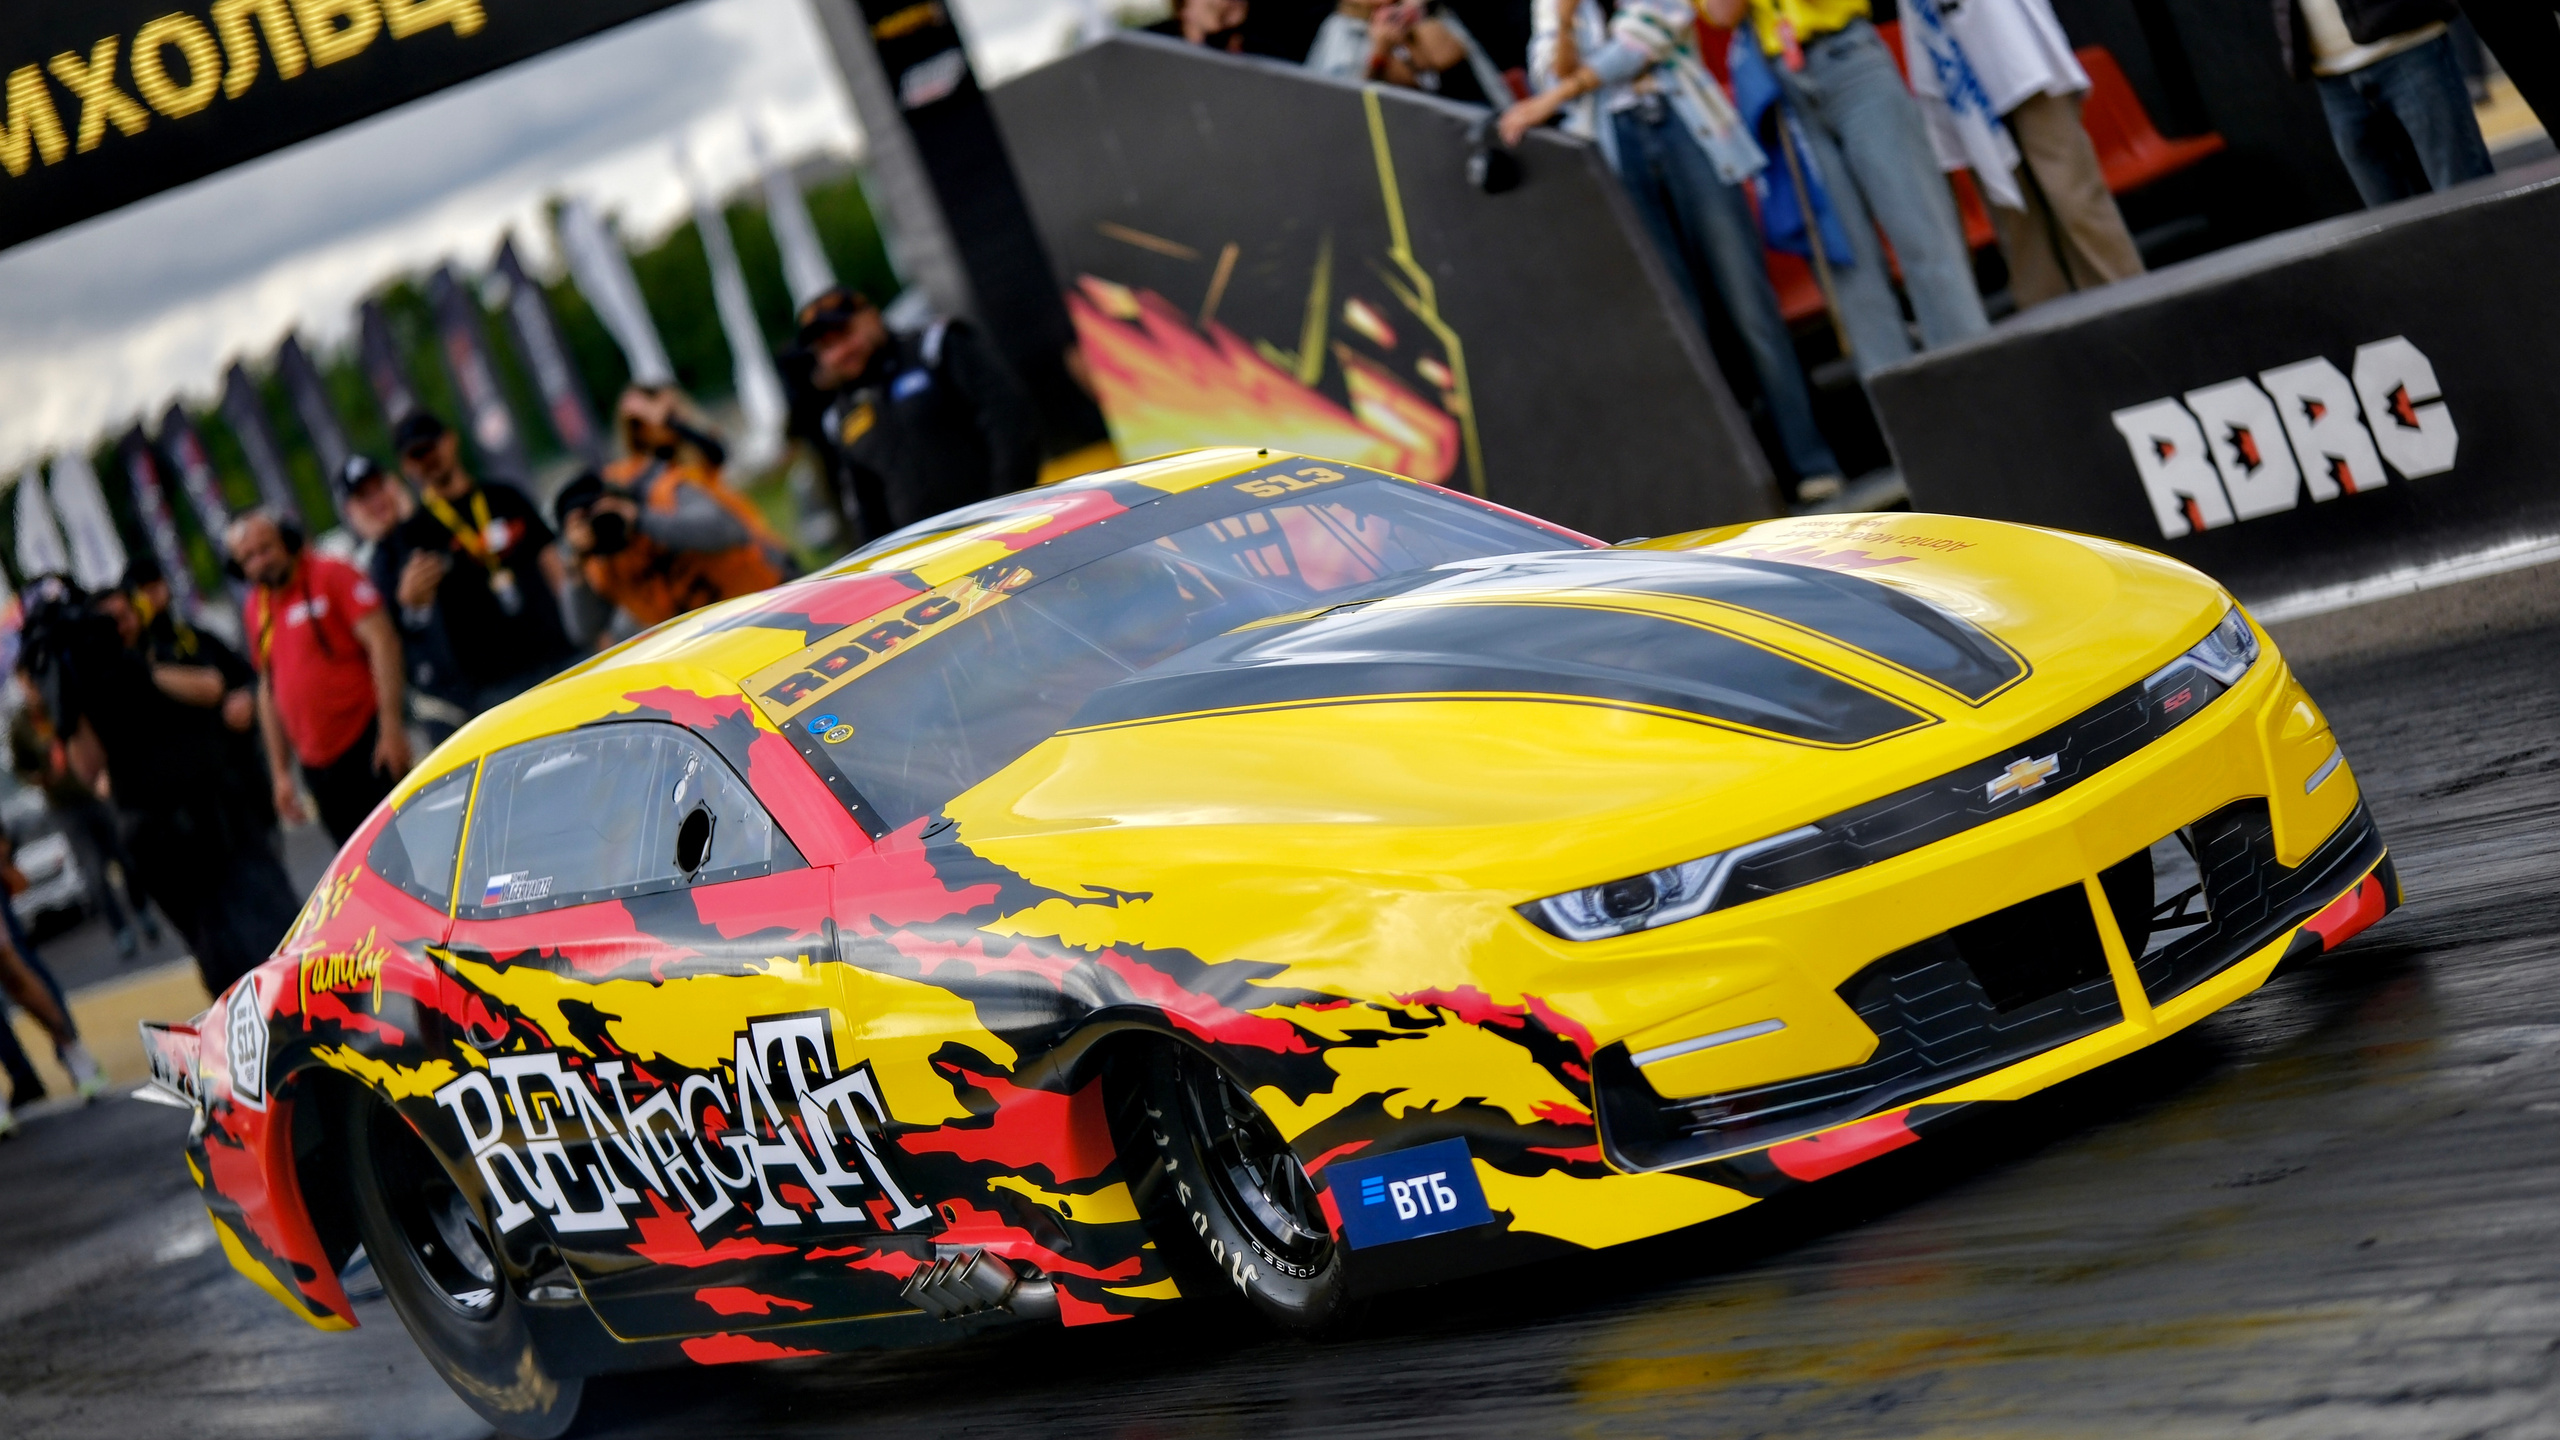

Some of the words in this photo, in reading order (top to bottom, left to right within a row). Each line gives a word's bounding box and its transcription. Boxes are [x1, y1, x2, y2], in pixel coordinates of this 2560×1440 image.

[2111, 335, 2459, 540] RDRC
[1232, 467, 1345, 498] 513
[1897, 535, 1978, 553] Alania
[759, 596, 961, 707] RDRC
[2164, 687, 2192, 714] SS
[299, 925, 391, 1015] Family
[237, 1020, 257, 1066] 513
[1145, 1098, 1261, 1299] HOOS
[1388, 1171, 1458, 1220] ВТБ
[1251, 1240, 1316, 1279] FORGED
